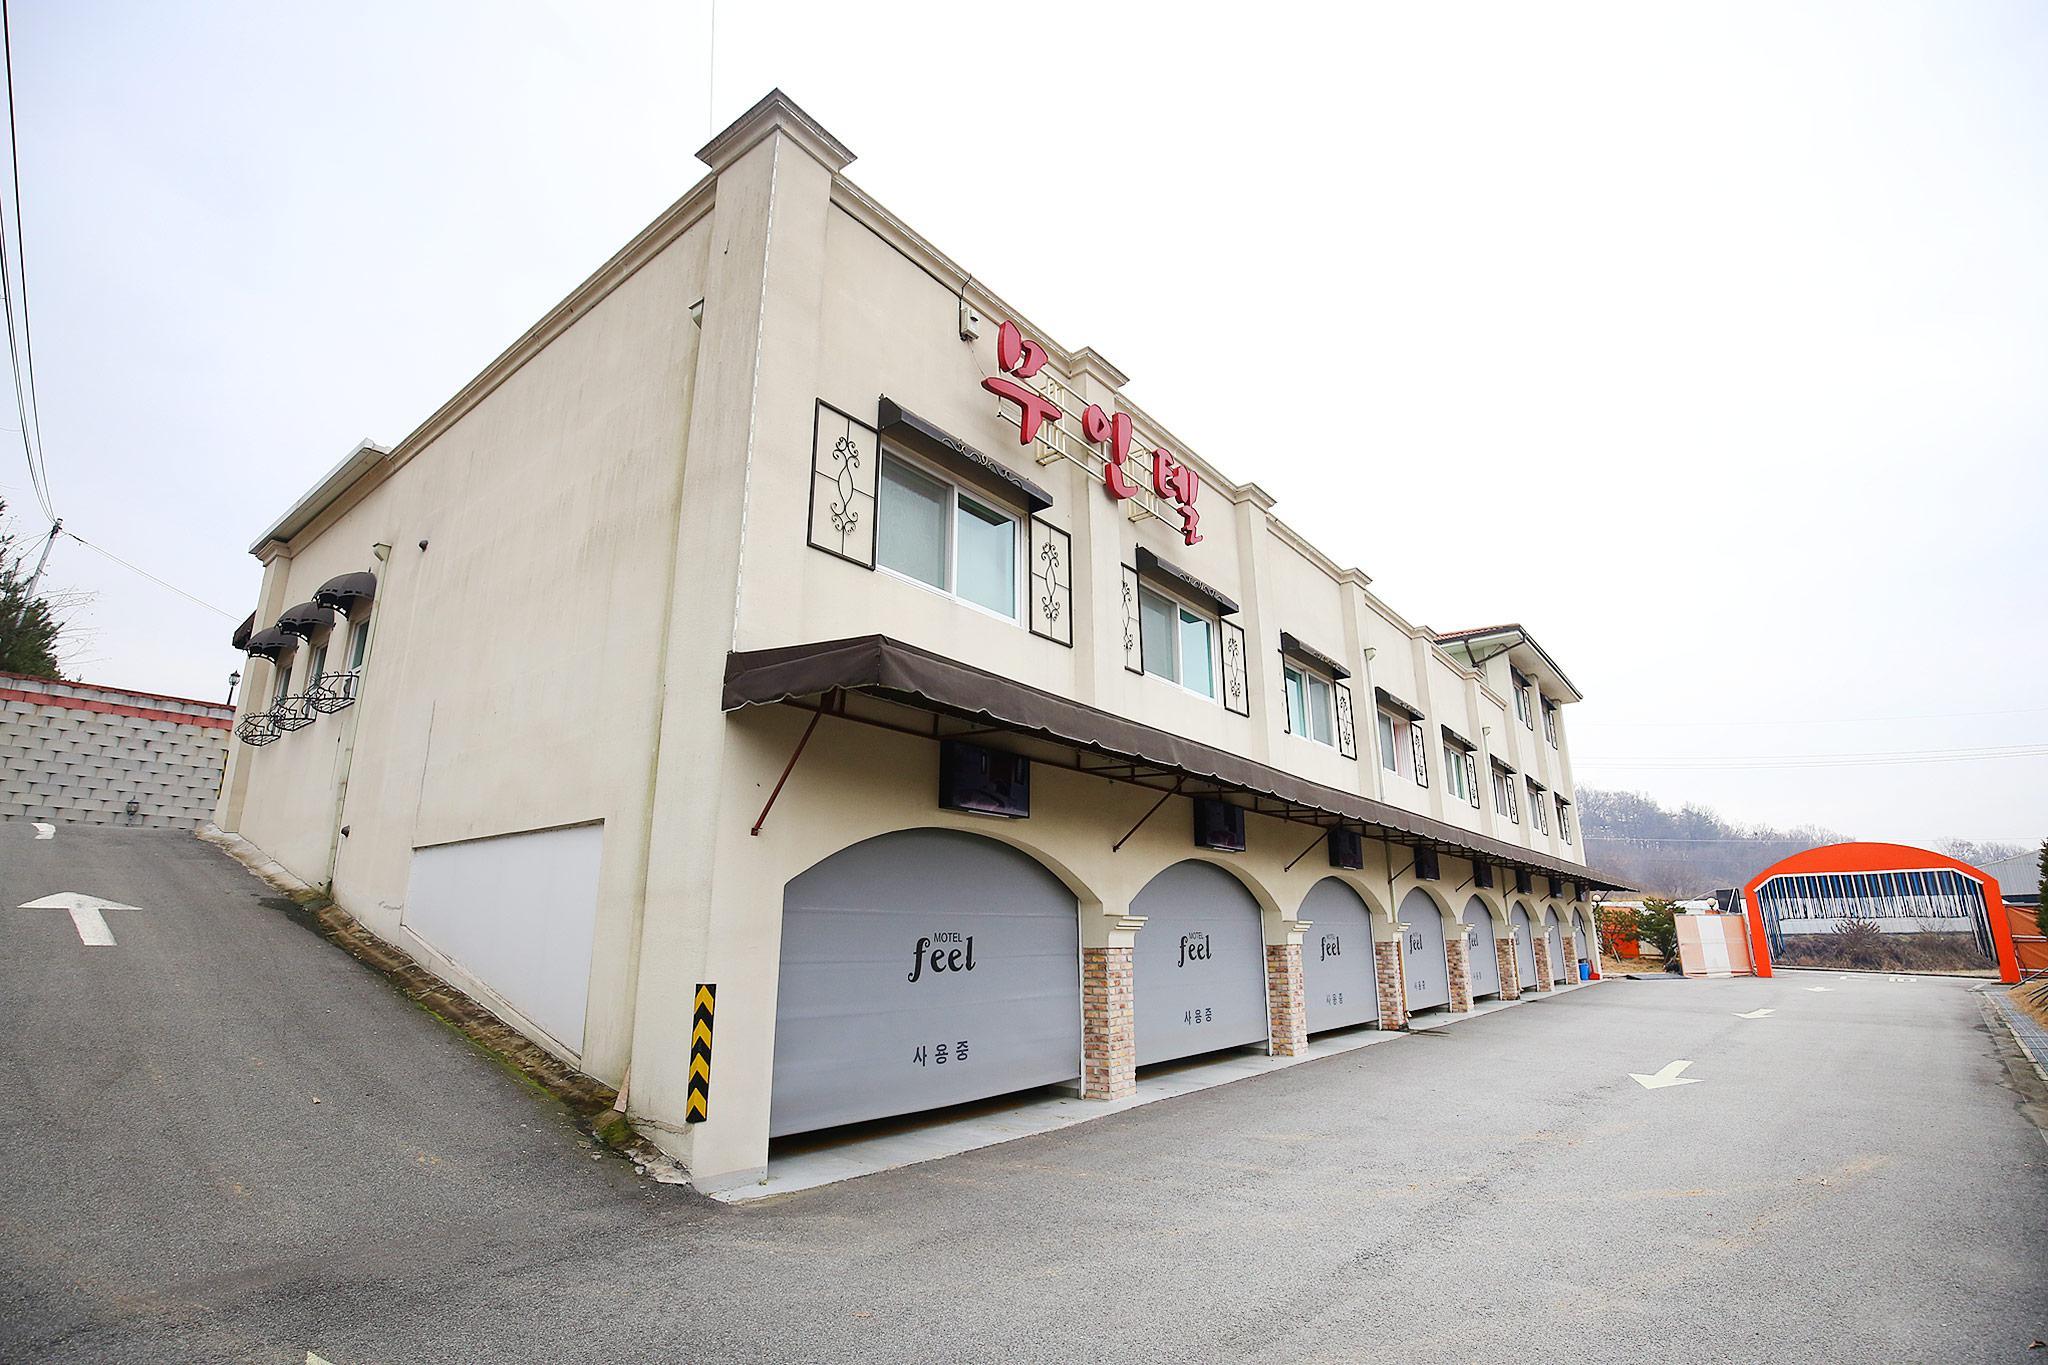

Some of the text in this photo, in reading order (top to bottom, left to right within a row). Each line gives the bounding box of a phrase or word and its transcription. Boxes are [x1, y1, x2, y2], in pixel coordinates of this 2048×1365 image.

[981, 320, 1203, 546] 무인텔
[934, 932, 963, 943] MOTEL
[1177, 934, 1212, 968] feel
[1320, 936, 1341, 961] feel
[907, 936, 976, 982] feel
[912, 1040, 969, 1067] 사용중
